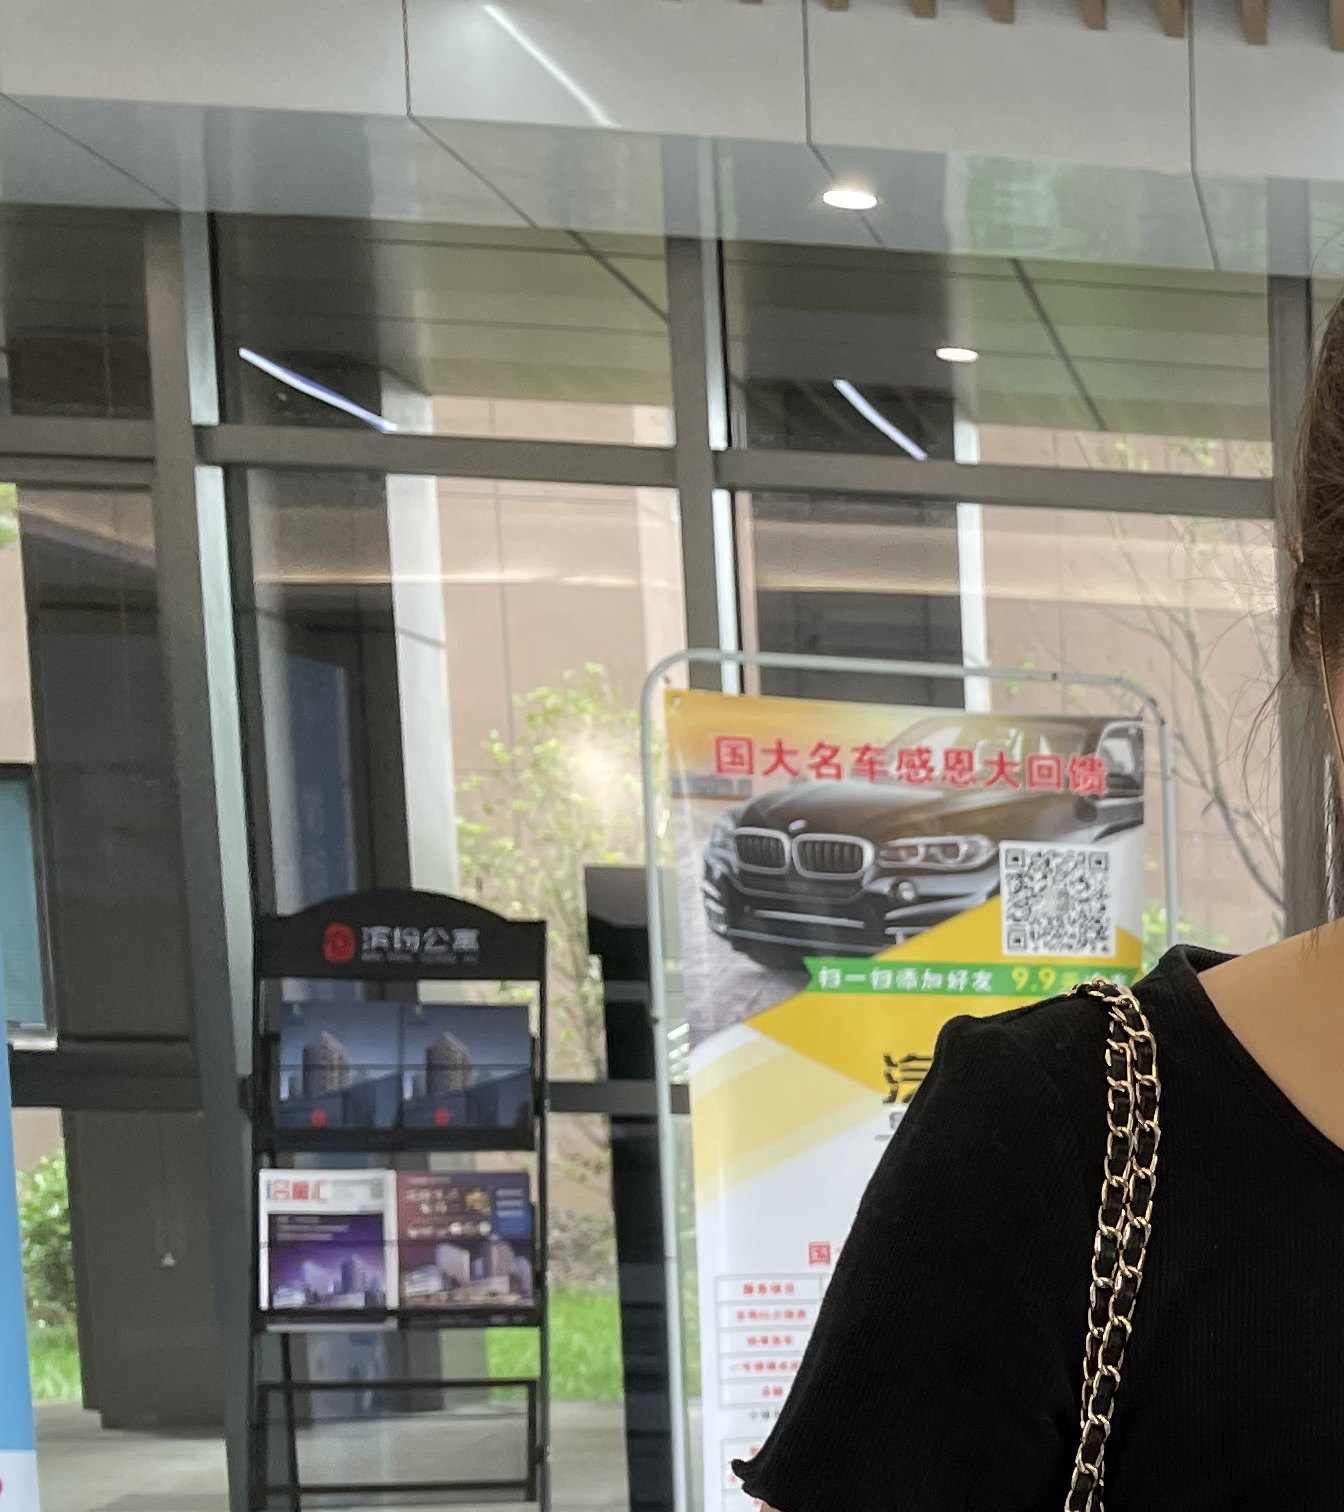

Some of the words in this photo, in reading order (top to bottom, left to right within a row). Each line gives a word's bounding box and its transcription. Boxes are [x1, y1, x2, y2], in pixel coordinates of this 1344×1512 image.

[713, 735, 1109, 797] 国大名车感恩大回馈
[817, 966, 994, 994] 扫一扫添加好友
